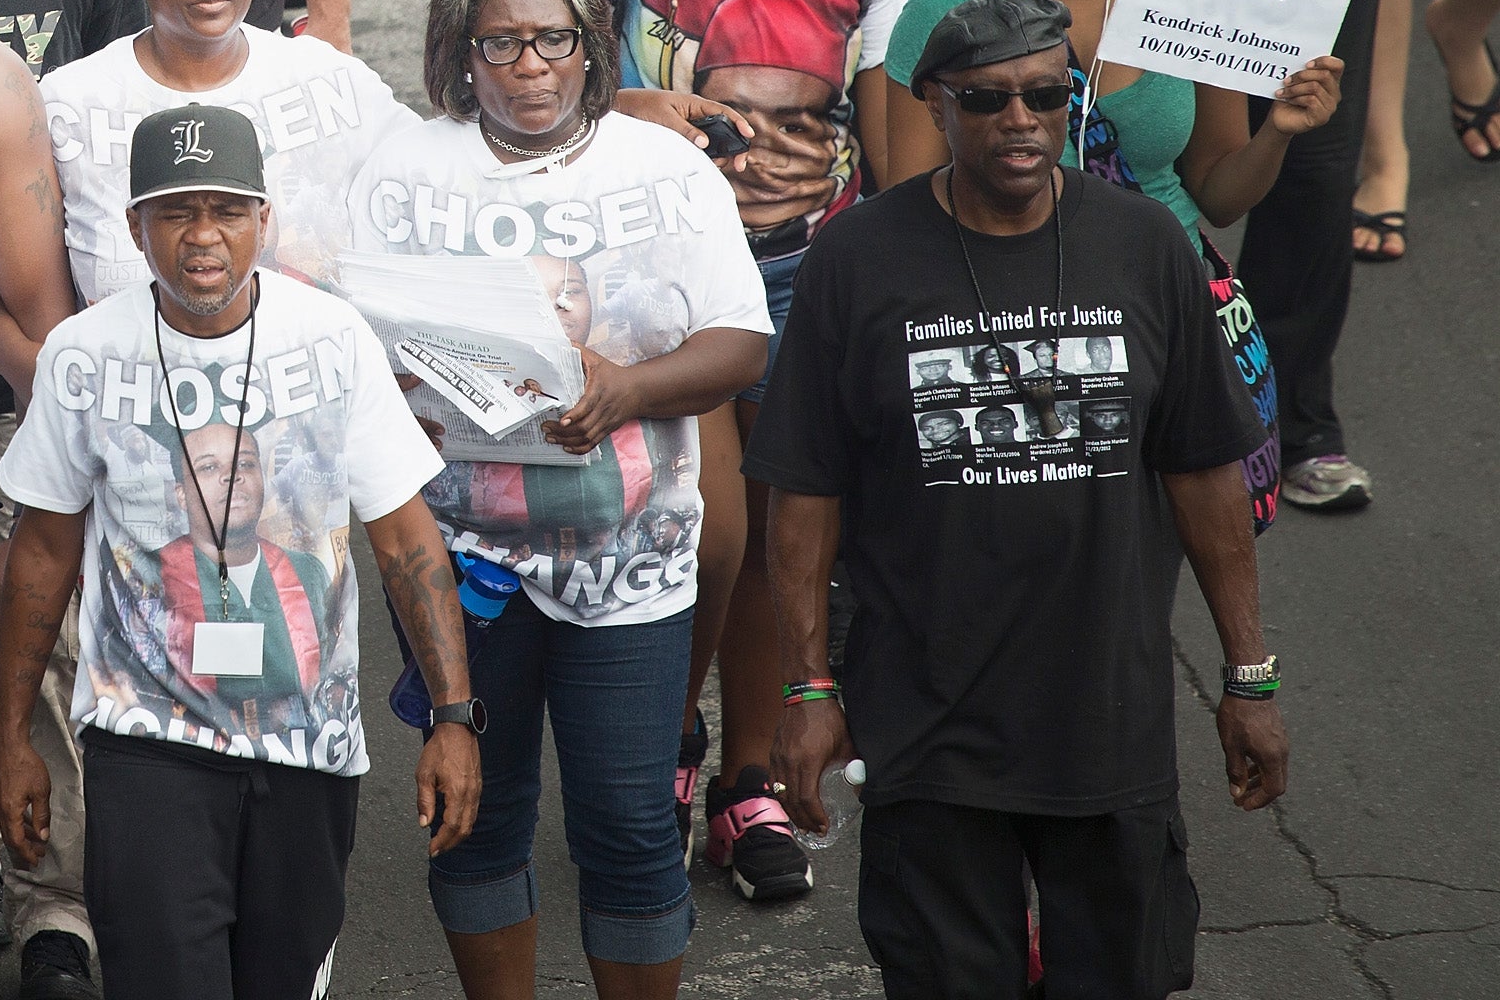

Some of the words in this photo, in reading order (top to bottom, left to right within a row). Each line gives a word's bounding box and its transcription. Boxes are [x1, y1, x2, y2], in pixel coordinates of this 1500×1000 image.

[1141, 8, 1224, 39] Kendrick
[1226, 28, 1301, 57] Johnson
[1138, 34, 1289, 82] 10/10/95-01/10/13
[49, 68, 360, 166] CHEN
[171, 119, 214, 166] L
[370, 174, 705, 258] CHOSEN
[435, 335, 456, 347] TASK
[459, 342, 490, 353] AHEAD
[905, 314, 974, 342] Families
[979, 306, 1033, 332] United
[1040, 306, 1066, 327] For
[1072, 305, 1123, 326] Justice
[53, 328, 357, 430] CHOSEN
[962, 467, 992, 485] Our
[997, 466, 1038, 485] Lives
[1042, 463, 1094, 482] Matter
